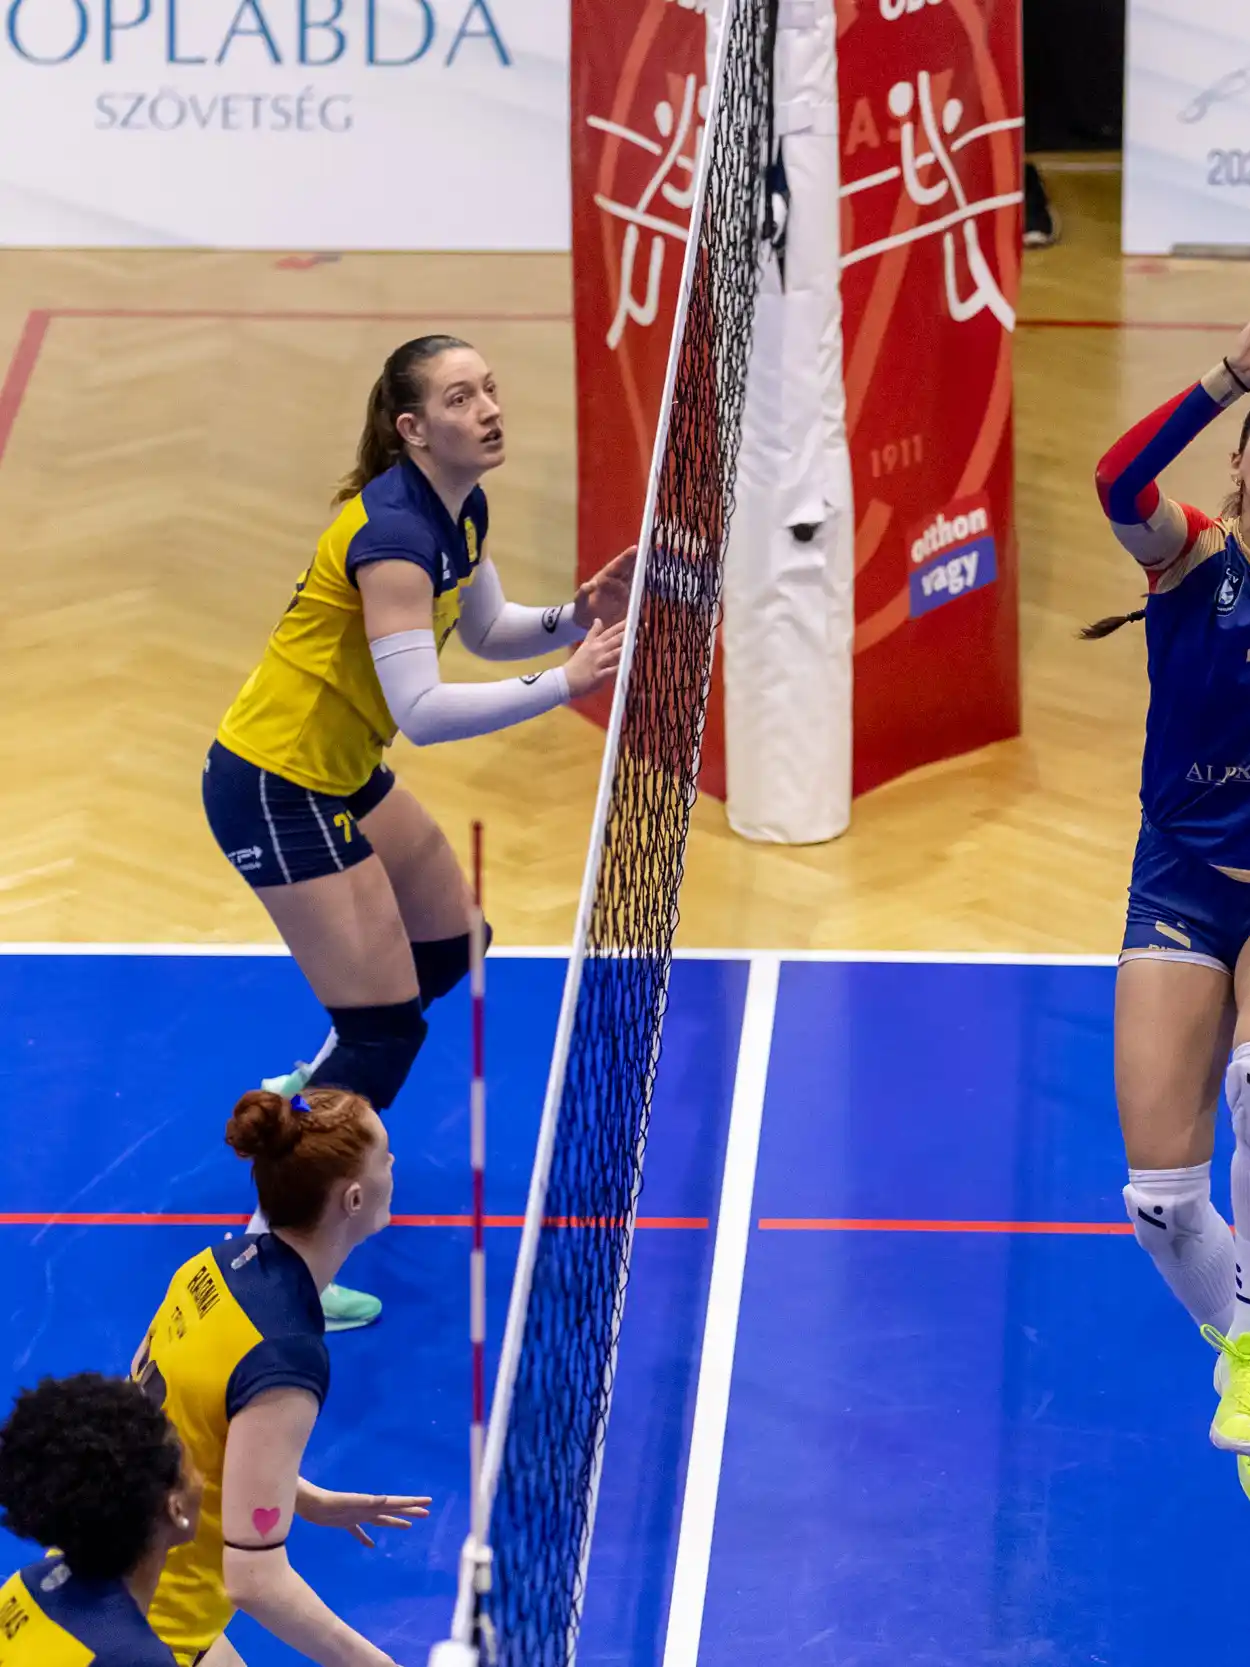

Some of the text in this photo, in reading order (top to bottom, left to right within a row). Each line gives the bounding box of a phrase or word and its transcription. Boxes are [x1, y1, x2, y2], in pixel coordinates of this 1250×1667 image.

[94, 87, 352, 132] SZÖVETSÉG
[871, 434, 923, 478] 1911
[910, 507, 989, 563] otthon
[920, 550, 979, 597] vagy
